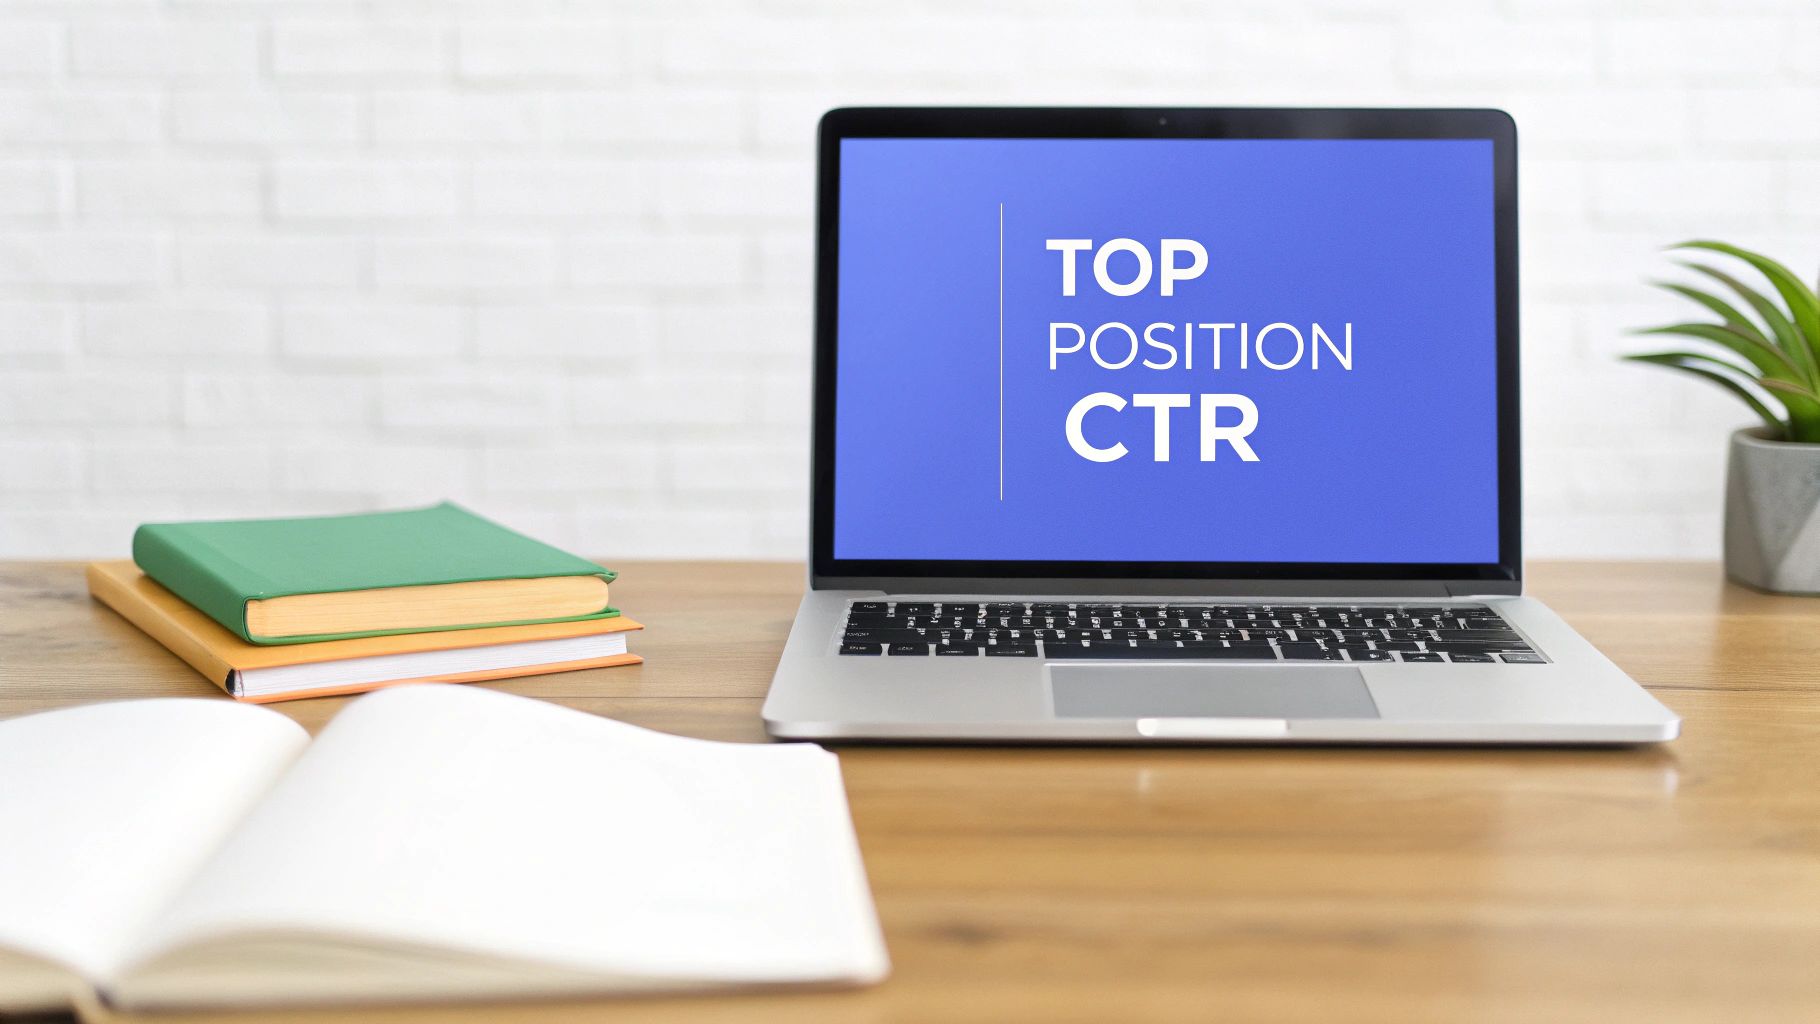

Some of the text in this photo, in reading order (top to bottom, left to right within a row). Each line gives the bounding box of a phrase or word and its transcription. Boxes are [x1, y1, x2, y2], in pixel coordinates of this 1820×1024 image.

[1046, 238, 1209, 297] TOP
[1049, 322, 1353, 371] POSITION
[1065, 392, 1261, 463] CTR
